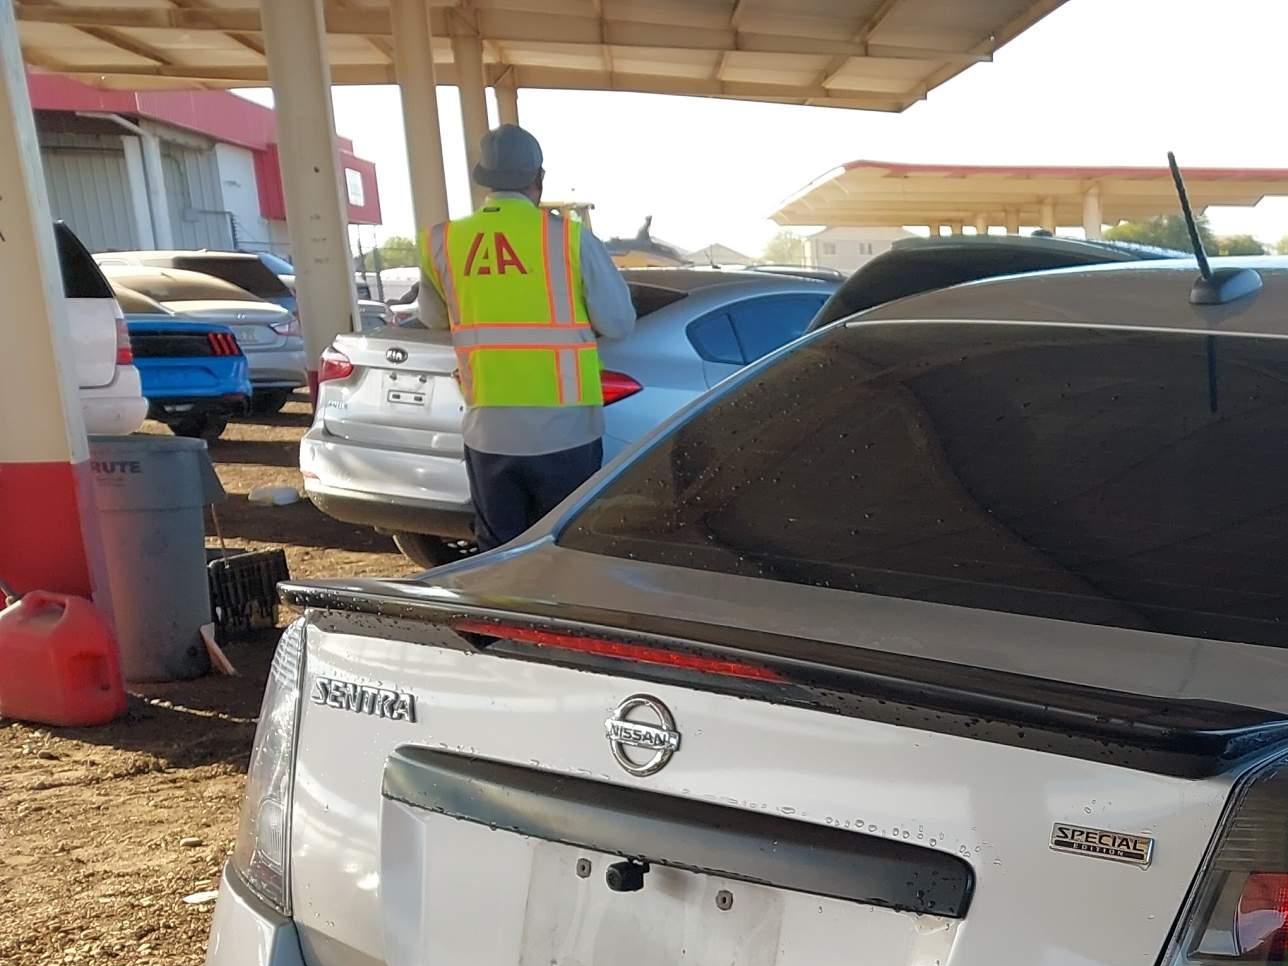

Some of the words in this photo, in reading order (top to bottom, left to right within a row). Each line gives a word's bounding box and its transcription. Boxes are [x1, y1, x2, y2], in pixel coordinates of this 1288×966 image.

[311, 676, 417, 723] SENTRA
[610, 724, 667, 746] NISSAN
[1056, 825, 1145, 853] SPECIAL
[1073, 842, 1125, 857] EDITION
